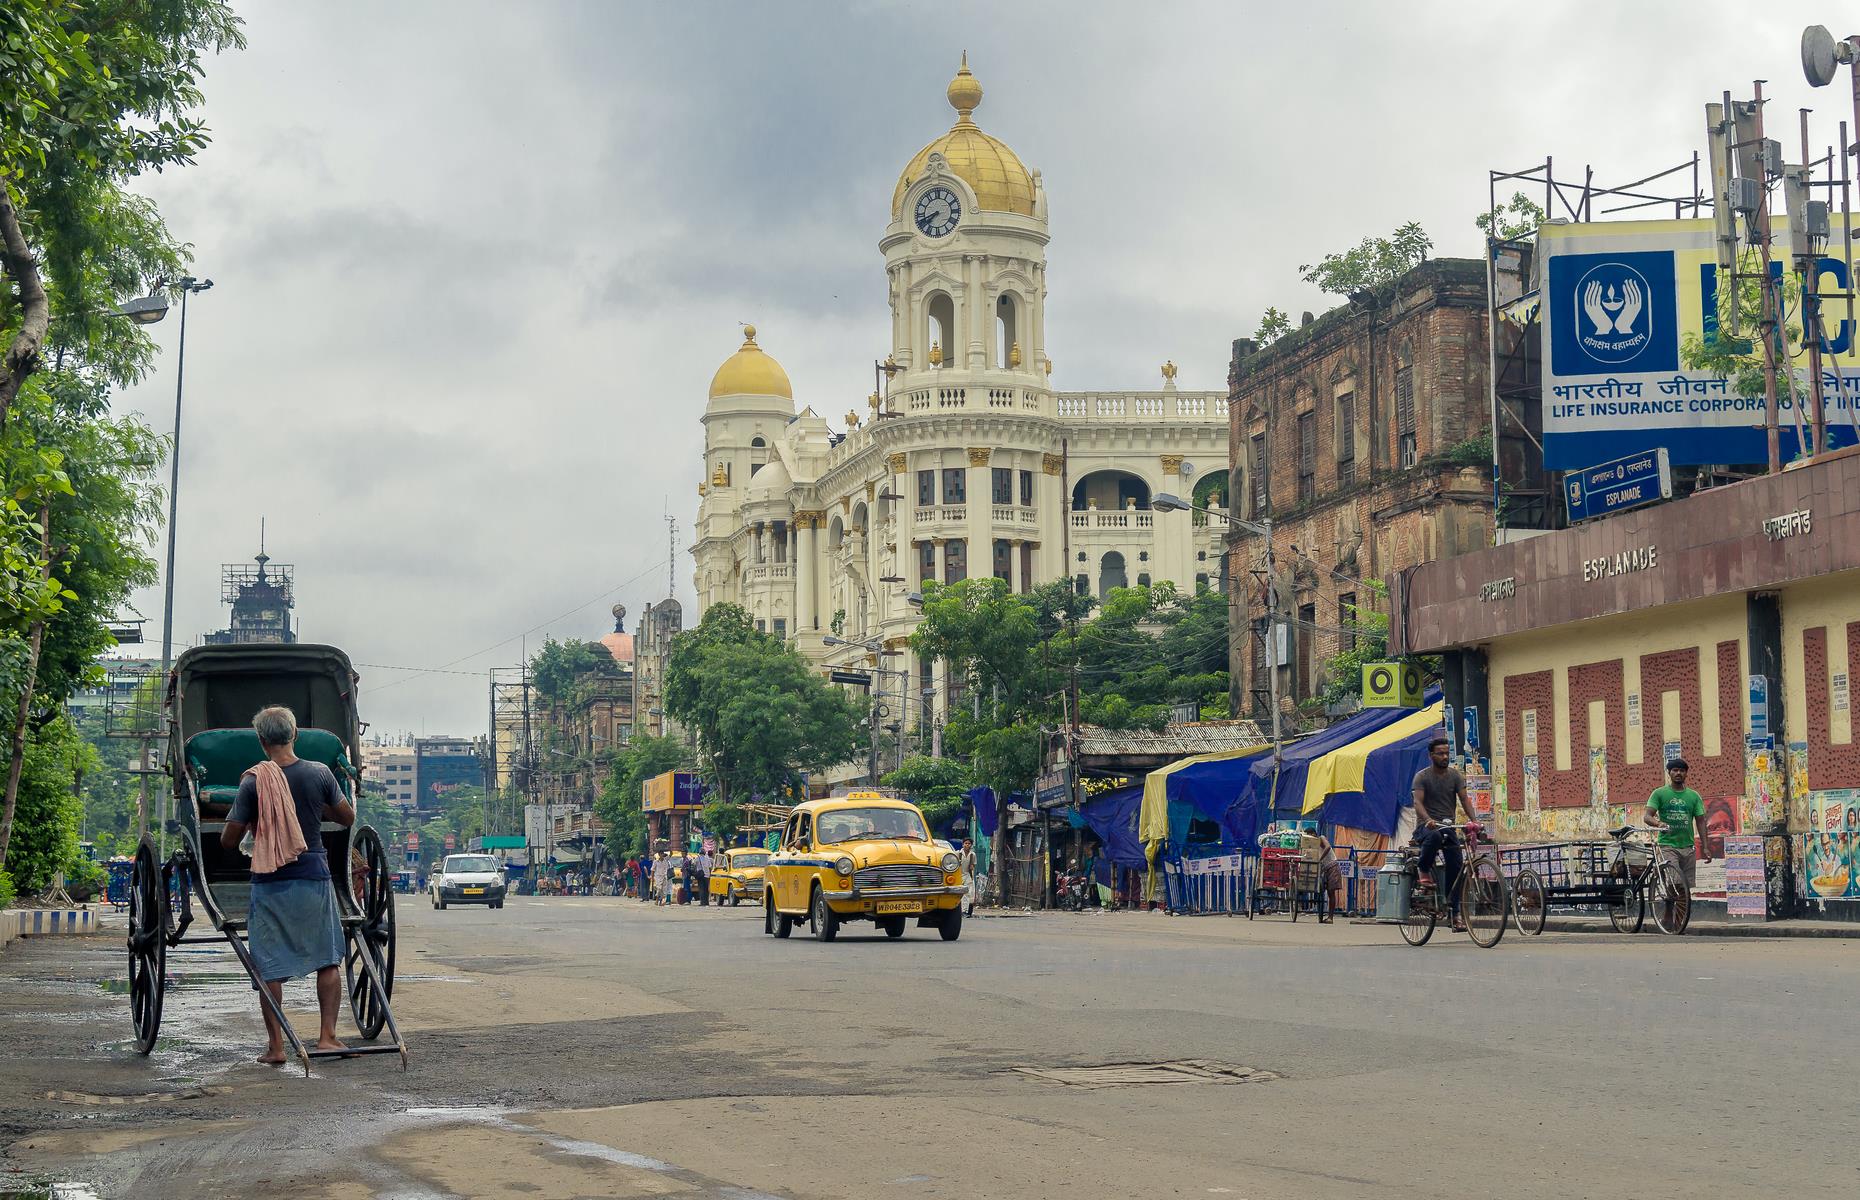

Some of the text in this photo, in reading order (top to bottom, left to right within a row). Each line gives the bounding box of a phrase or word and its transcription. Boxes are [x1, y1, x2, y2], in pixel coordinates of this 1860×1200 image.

[1700, 258, 1857, 354] LIC
[1553, 377, 1643, 400] भारतीय
[1552, 404, 1585, 418] LIFE
[1591, 399, 1684, 416] INSURANCE
[1606, 486, 1641, 506] ESPLANADE
[1583, 544, 1657, 582] ESPLANADE
